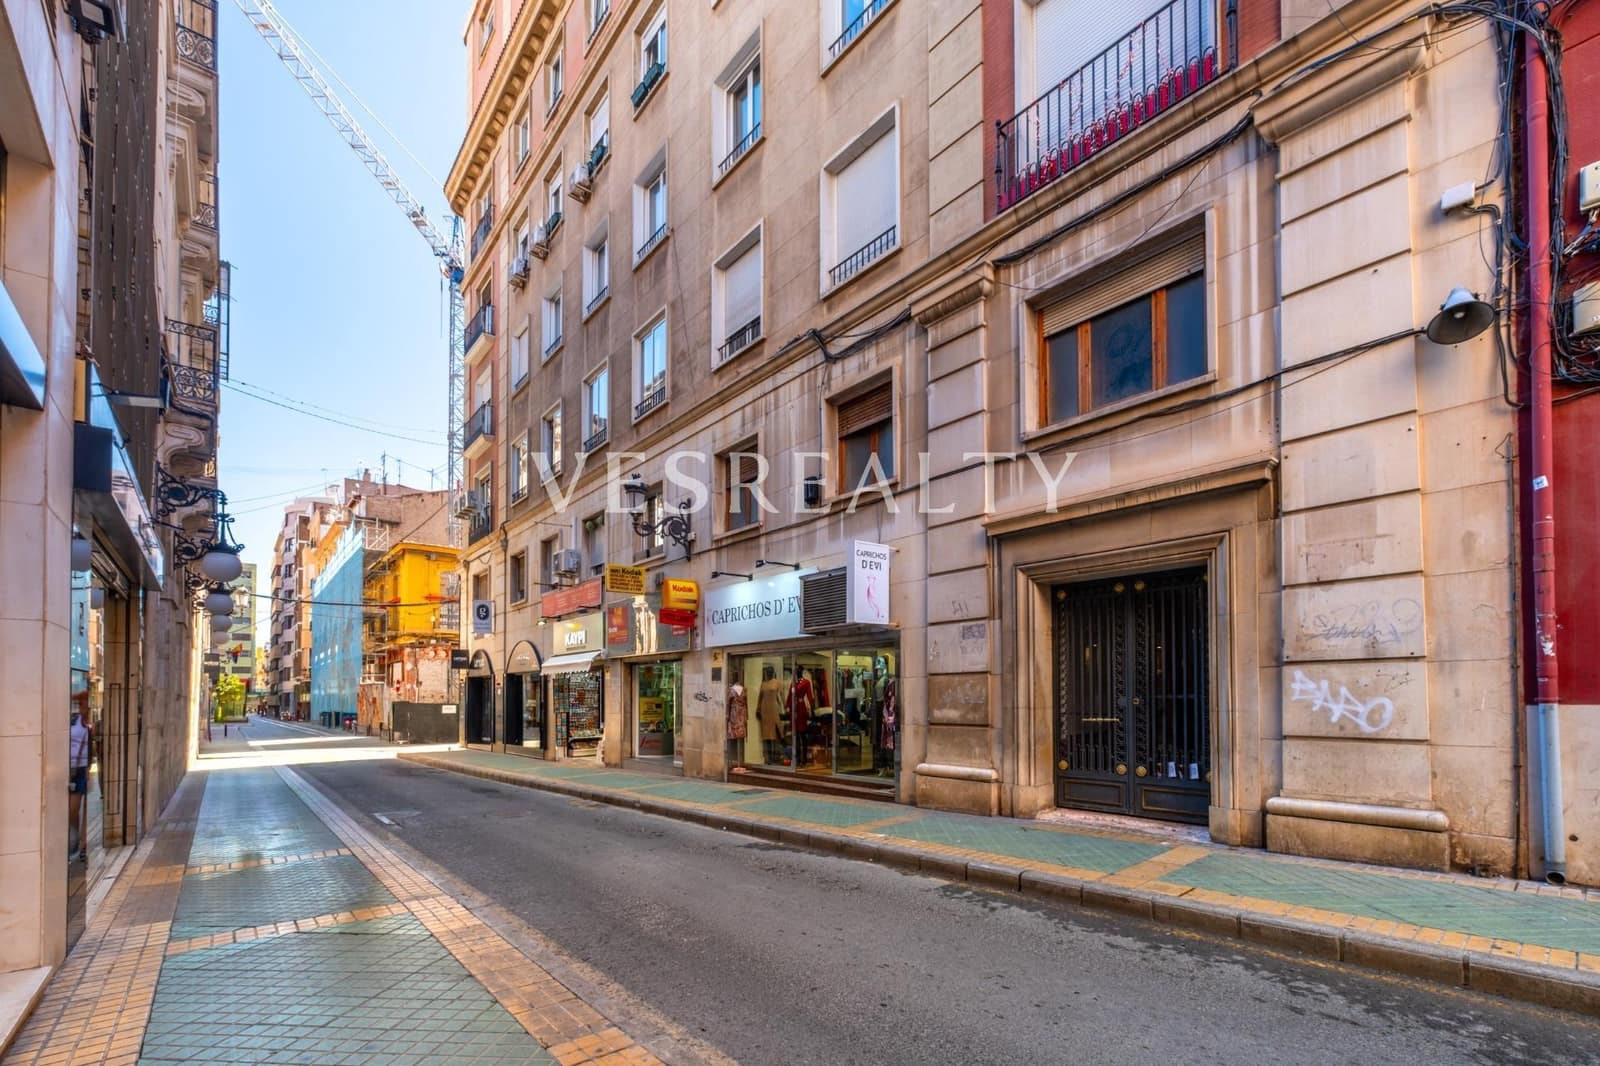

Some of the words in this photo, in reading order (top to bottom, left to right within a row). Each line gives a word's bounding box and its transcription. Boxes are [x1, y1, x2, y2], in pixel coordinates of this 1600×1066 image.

[855, 549, 888, 561] CAPRICHOS
[622, 568, 642, 576] Kodak
[672, 584, 694, 593] Kodak
[711, 601, 772, 625] CAPRICHOS
[565, 630, 586, 646] KAYPI
